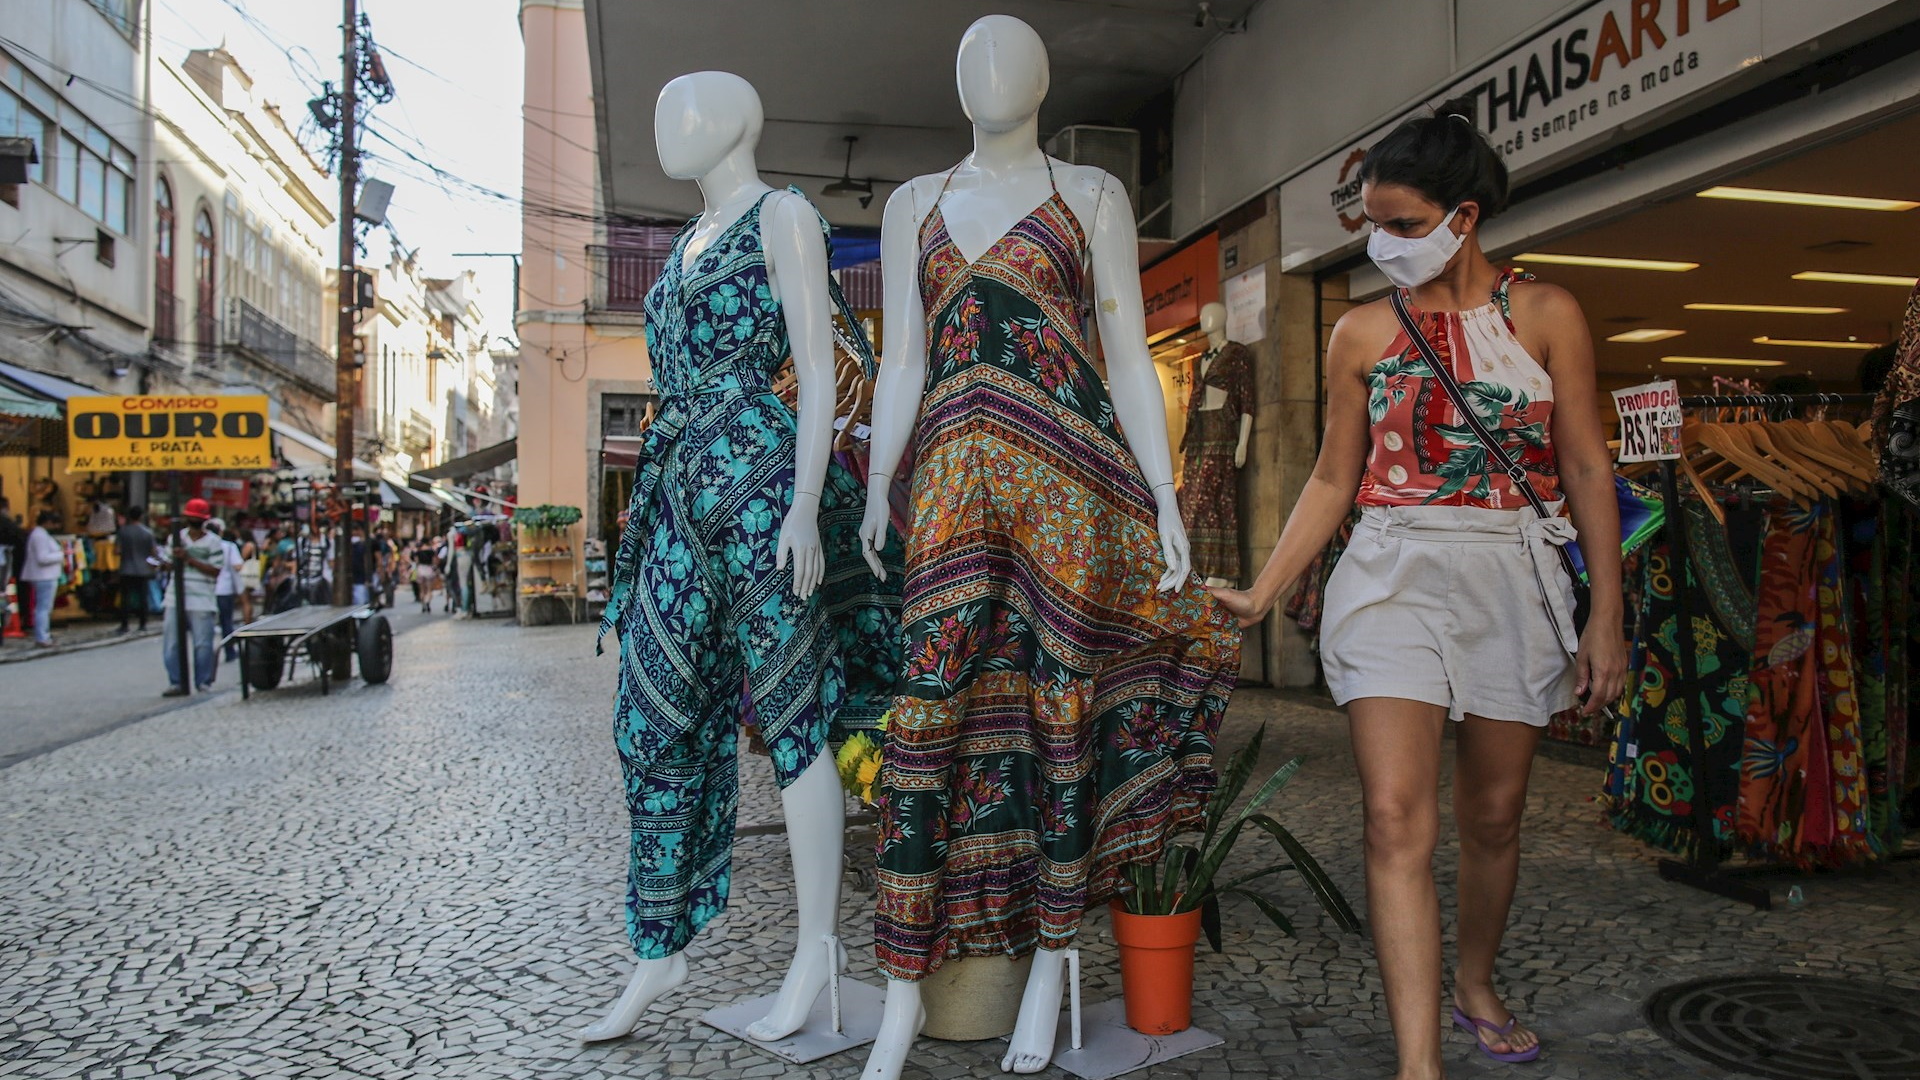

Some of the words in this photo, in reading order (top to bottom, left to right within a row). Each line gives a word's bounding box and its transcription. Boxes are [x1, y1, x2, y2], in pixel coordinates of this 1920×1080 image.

[1532, 98, 1598, 143] sempre
[1607, 84, 1631, 107] na
[1641, 51, 1698, 93] moda
[122, 397, 218, 411] COMPRO
[73, 411, 265, 440] OURO
[1623, 411, 1646, 460] R$
[131, 442, 139, 453] E
[151, 441, 203, 453] PRATA
[162, 456, 174, 467] 91
[185, 456, 222, 467] SALA
[232, 456, 261, 467] 304
